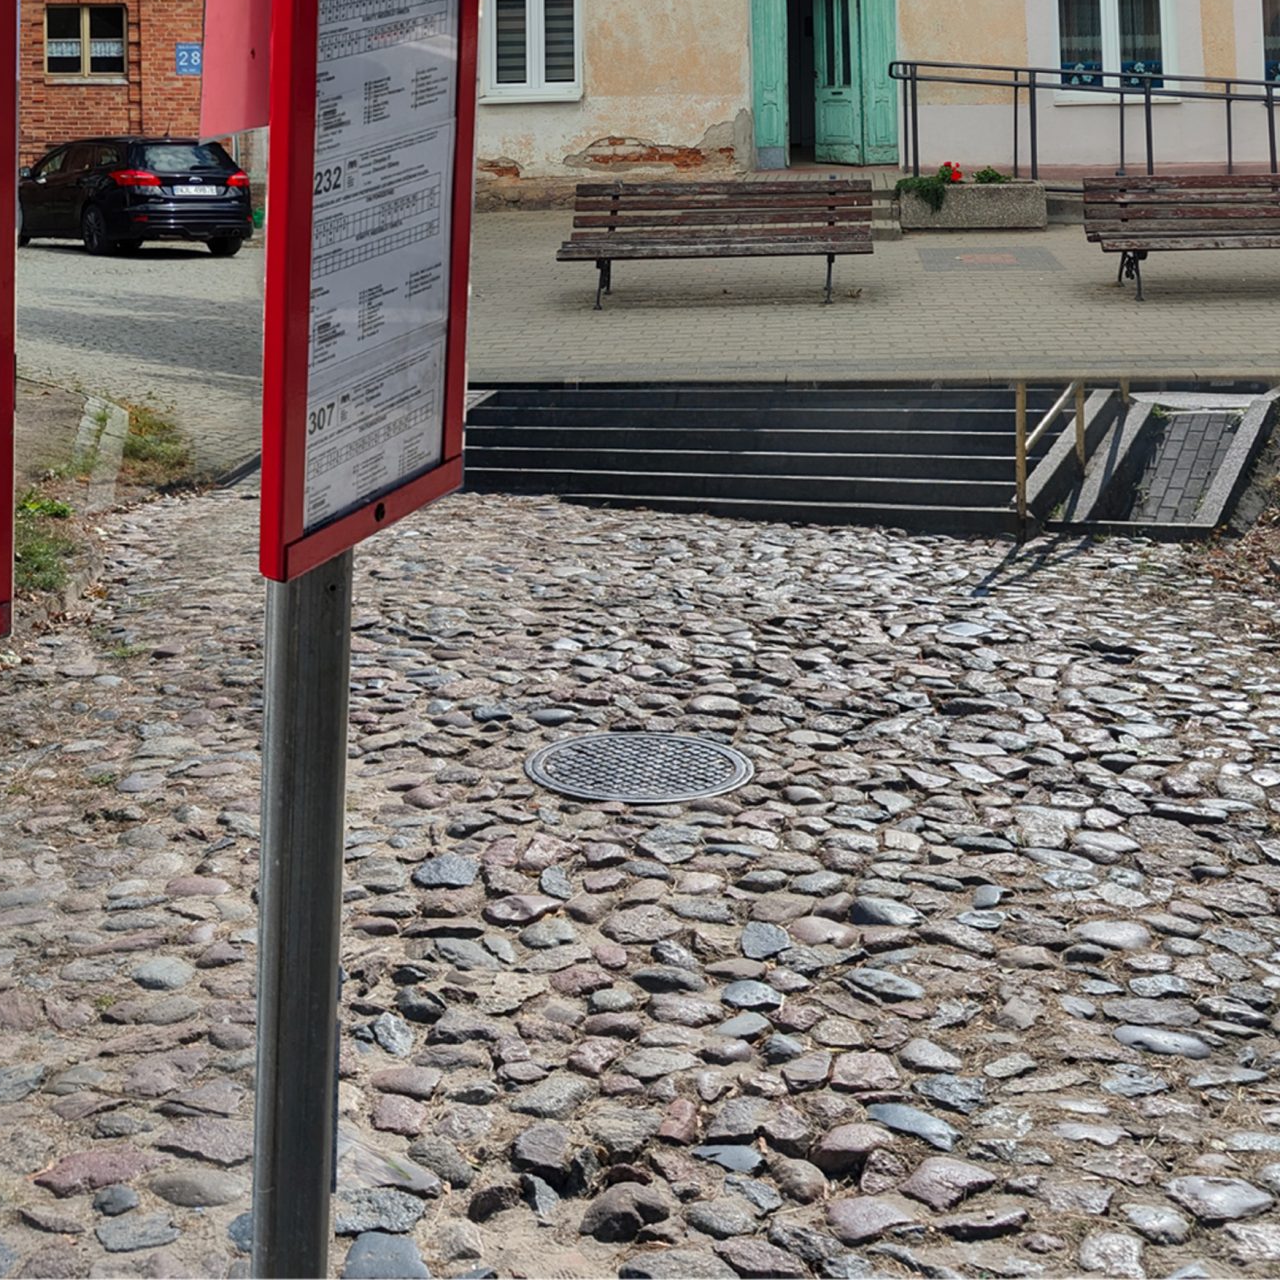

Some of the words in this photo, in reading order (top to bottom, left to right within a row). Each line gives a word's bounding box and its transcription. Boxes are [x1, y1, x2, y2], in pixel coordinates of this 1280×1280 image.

[179, 51, 200, 65] 28
[314, 166, 342, 196] 232
[308, 403, 335, 436] 307
